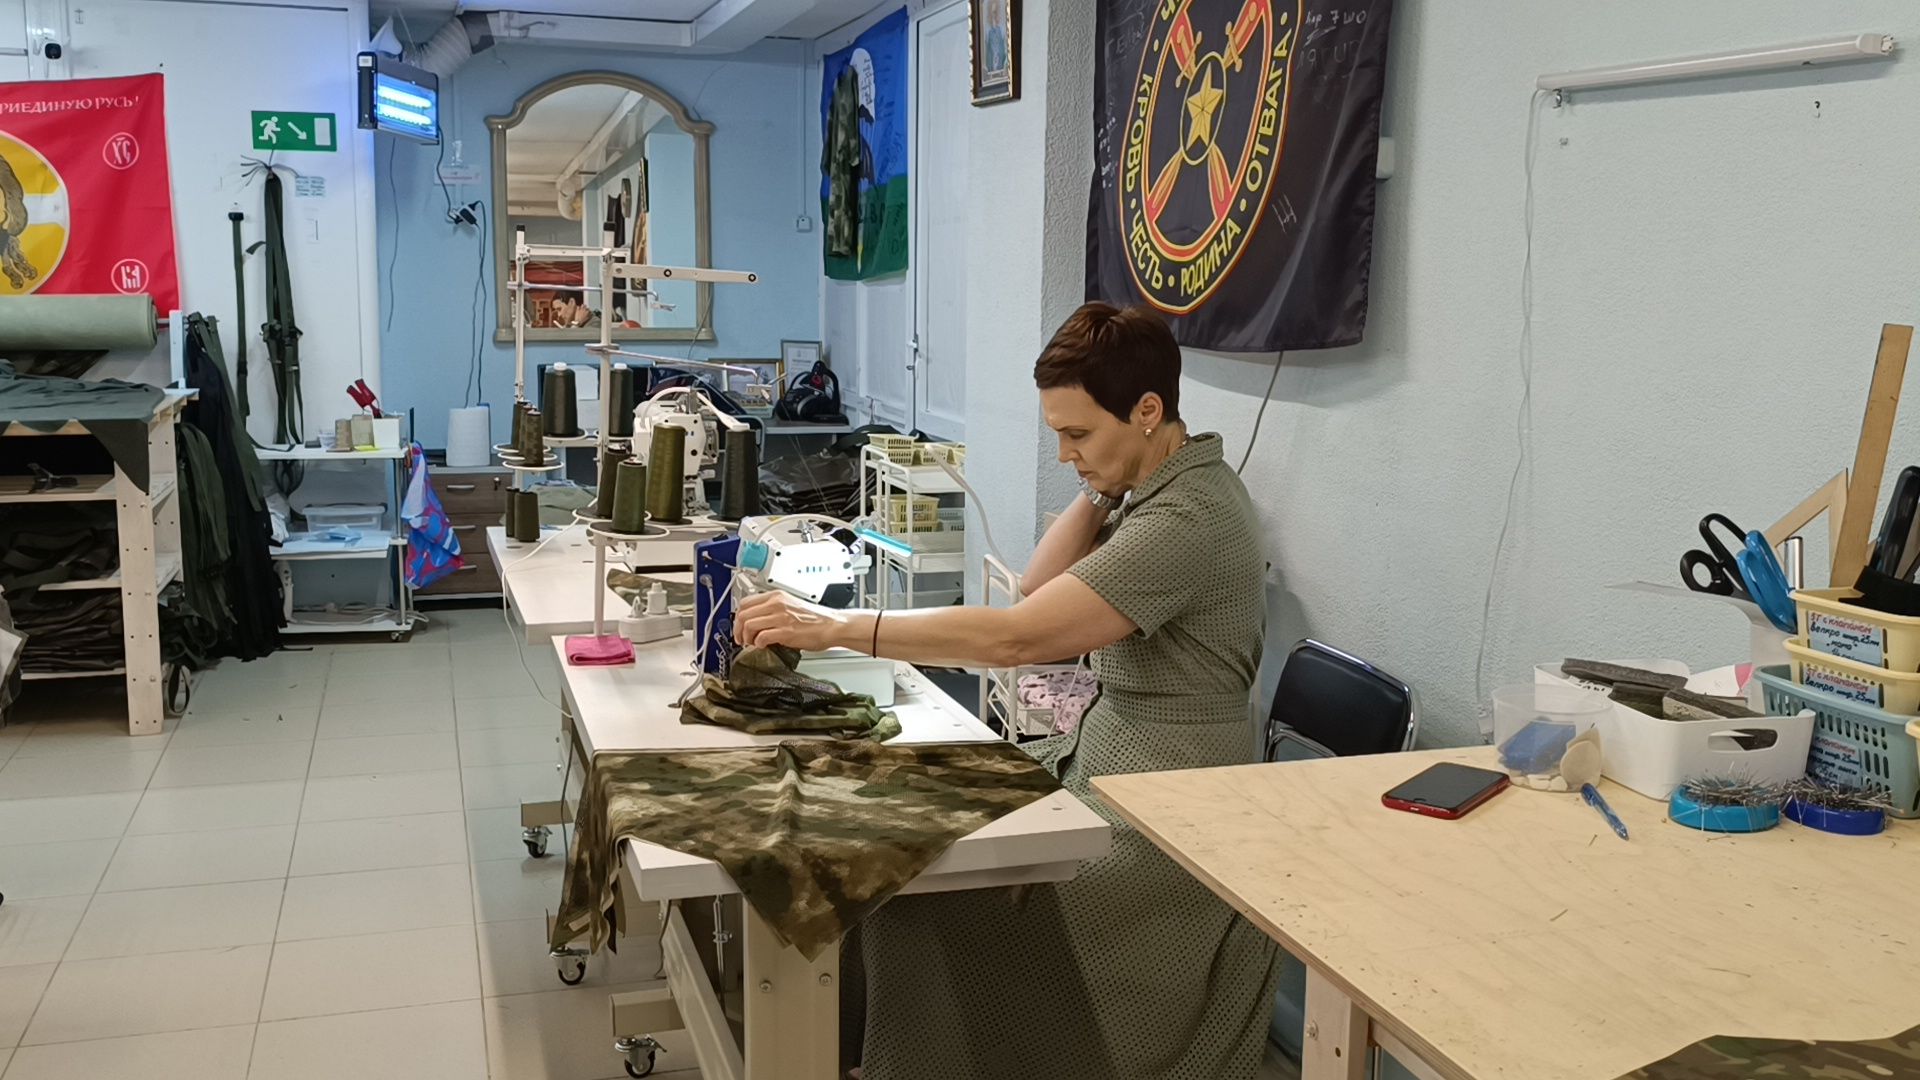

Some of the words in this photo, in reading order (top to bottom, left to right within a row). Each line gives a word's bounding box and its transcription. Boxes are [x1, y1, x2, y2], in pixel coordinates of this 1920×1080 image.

[95, 95, 139, 110] РУСЬ!
[1126, 73, 1153, 192] КРОВЬ
[1245, 28, 1292, 192] ОТВАГА
[1129, 209, 1163, 290] ЧЕСТЬ
[1181, 217, 1241, 297] РОДИНА
